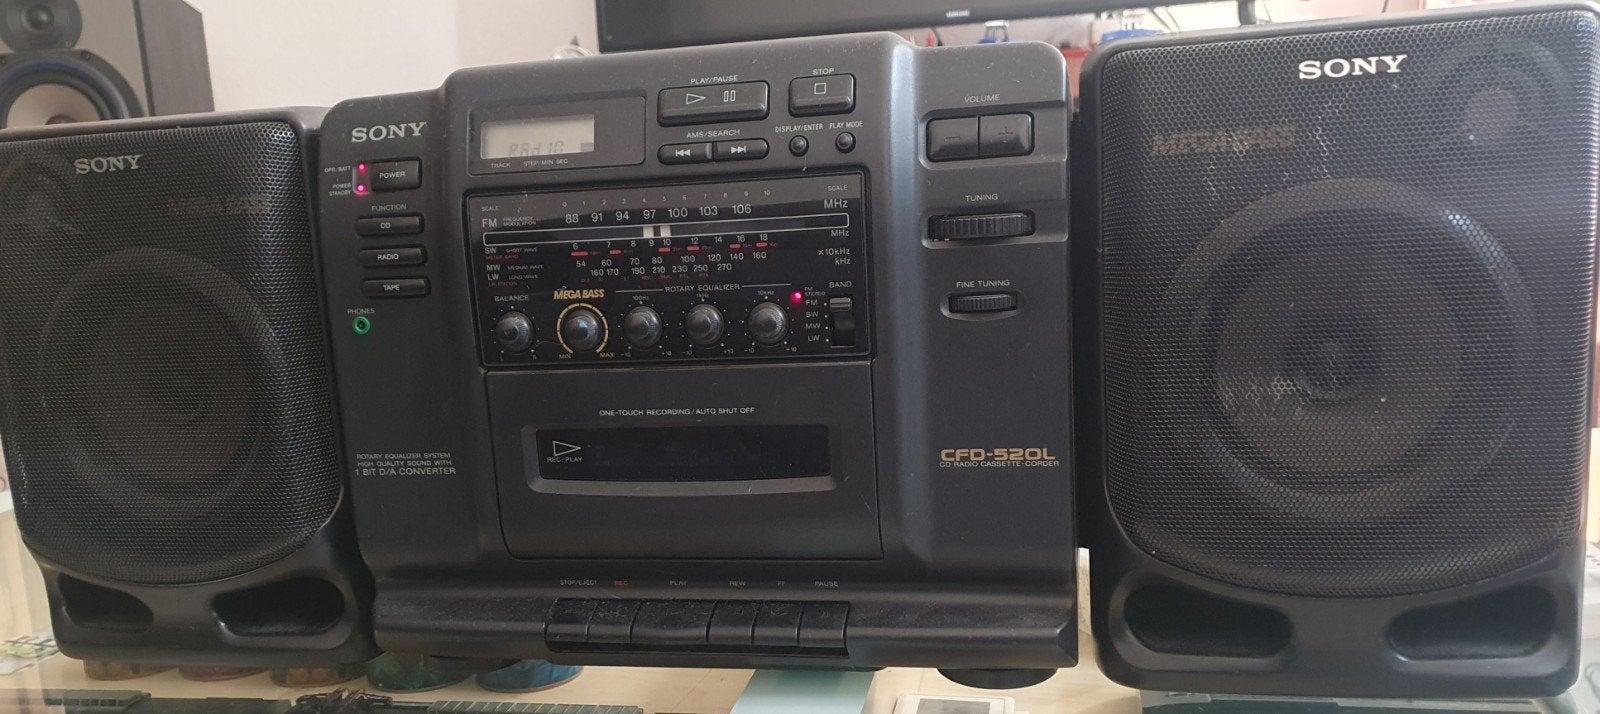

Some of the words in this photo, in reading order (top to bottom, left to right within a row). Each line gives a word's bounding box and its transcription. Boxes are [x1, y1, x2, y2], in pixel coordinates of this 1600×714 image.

[1298, 54, 1408, 79] SONY
[690, 75, 738, 84] PLAY/PAUSE
[964, 94, 1000, 103] VOLUME
[775, 124, 824, 133] DISPLAY/ENTER
[846, 120, 863, 128] MODE
[351, 121, 426, 142] SONY
[686, 129, 740, 138] AMS/SEARCH
[74, 154, 143, 174] SONY
[379, 171, 406, 179] POWER
[965, 194, 999, 202] TUNING
[482, 218, 498, 228] FM
[565, 213, 579, 223] 88
[591, 212, 603, 222] 91
[616, 211, 630, 221] 94
[643, 209, 656, 219] 97
[668, 207, 688, 218] 100
[699, 205, 718, 216] 103
[731, 203, 752, 214] 106
[824, 199, 848, 209] MHz
[485, 247, 497, 255] SW
[760, 233, 768, 241] 18
[831, 229, 850, 237] MHz
[681, 255, 695, 263] 100
[730, 252, 744, 260] 140
[752, 251, 767, 259] 160
[606, 268, 619, 276] 170
[631, 267, 645, 275] 190
[652, 266, 666, 274] 210
[671, 265, 688, 273] 230
[693, 264, 708, 272] 250
[717, 263, 732, 271] 270
[697, 283, 740, 291] EQUALIZER
[978, 279, 1010, 287] TUNING
[495, 294, 529, 302] BALANCE
[554, 290, 582, 300] MEGA
[582, 289, 605, 299] BASS
[940, 447, 1056, 461] CFD-520L
[980, 460, 1059, 468] CASSETTE-CORDER
[362, 468, 376, 476] BIT
[379, 468, 397, 476] D/A
[398, 467, 457, 475] CONVERTER
